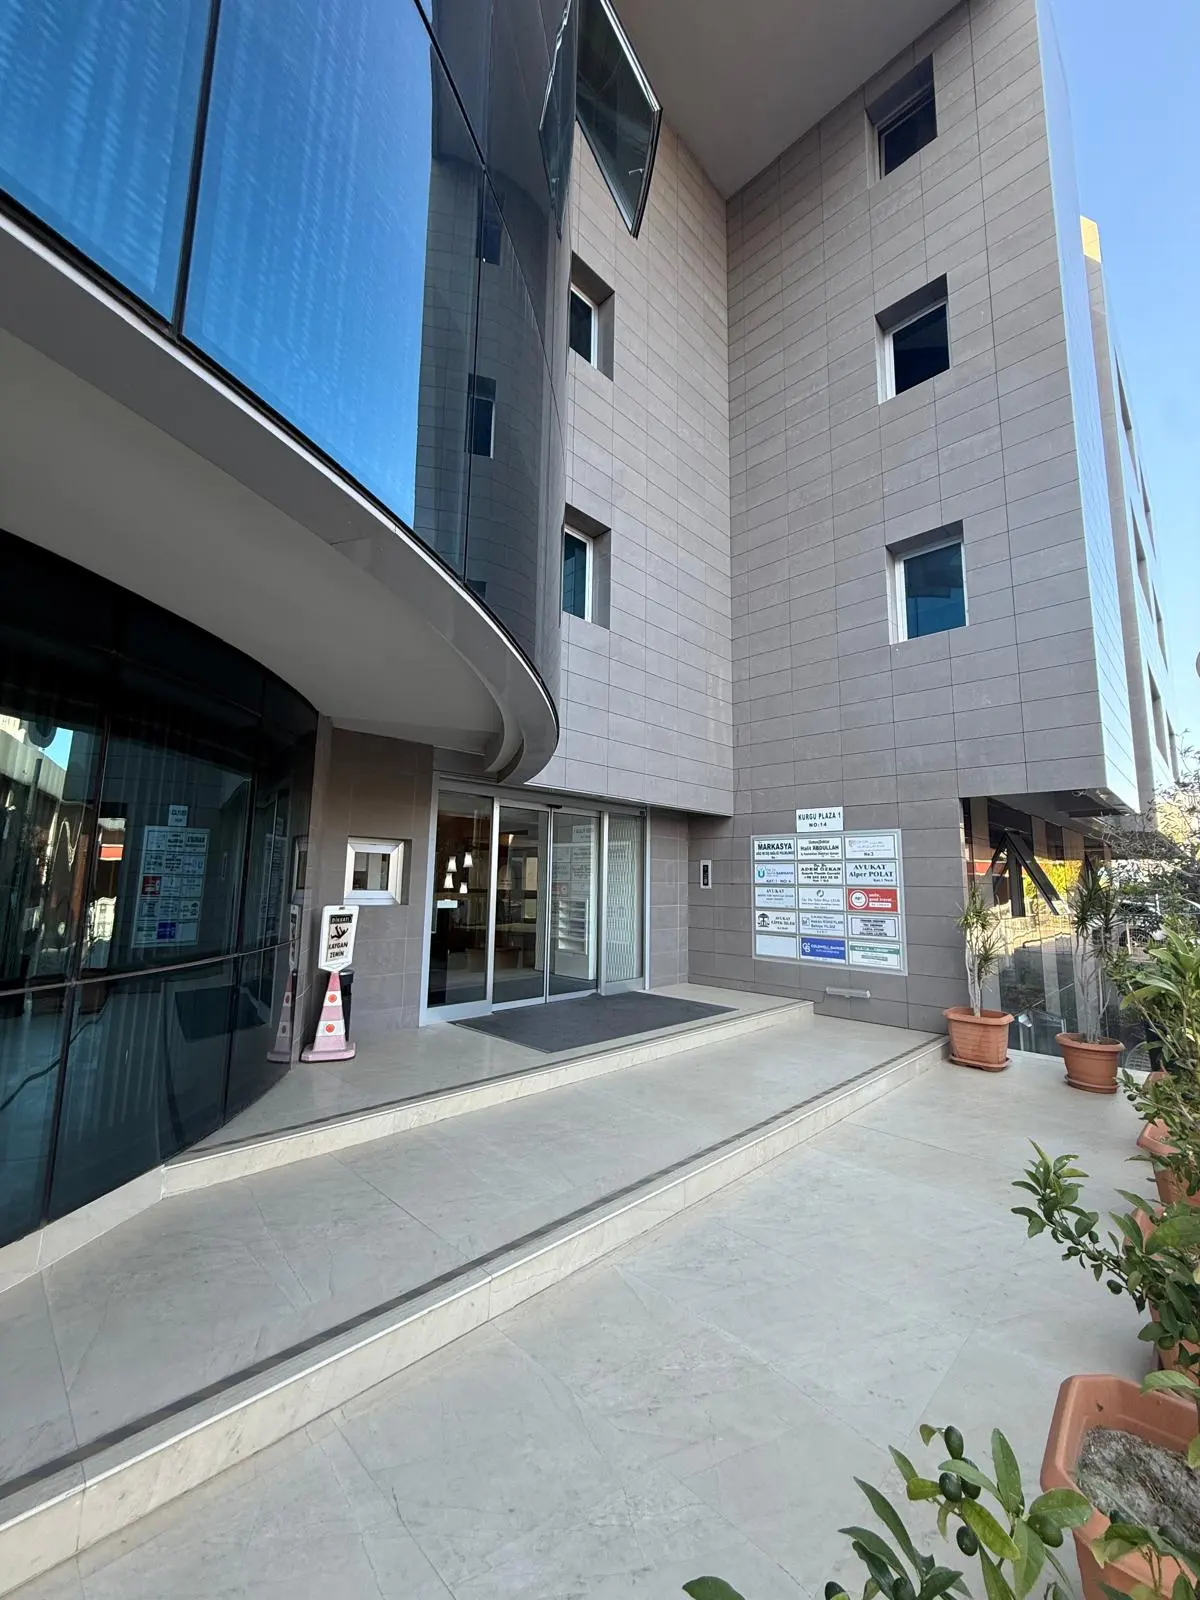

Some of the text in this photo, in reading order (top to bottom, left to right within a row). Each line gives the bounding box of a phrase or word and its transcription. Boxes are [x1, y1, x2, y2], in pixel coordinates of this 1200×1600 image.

[798, 813, 817, 821] KURGU
[818, 812, 836, 820] PLAZA
[757, 843, 793, 851] MARKASYA
[848, 871, 867, 879] Alper
